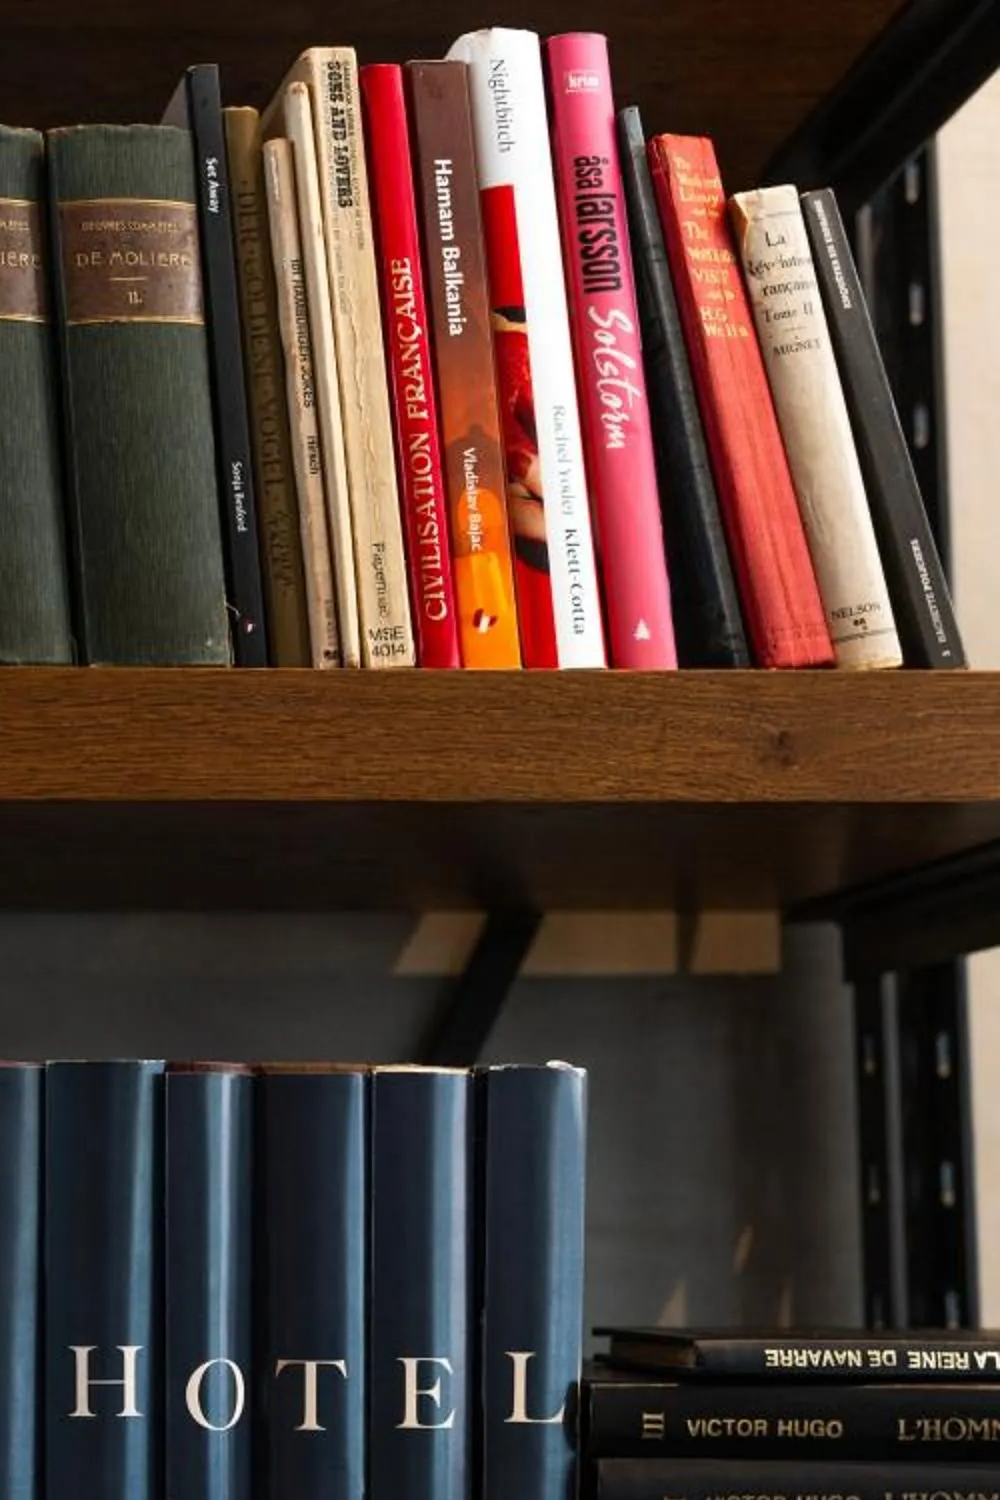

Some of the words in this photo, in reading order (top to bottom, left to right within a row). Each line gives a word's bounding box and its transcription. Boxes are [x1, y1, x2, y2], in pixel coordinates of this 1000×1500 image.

[330, 107, 346, 140] AND
[488, 58, 515, 152] Nightbitch
[433, 159, 455, 244] Hamam
[572, 155, 609, 190] åsa
[76, 252, 101, 268] DE
[574, 192, 624, 295] larsson
[441, 247, 466, 336] Balkania
[390, 257, 429, 421] FRANÇAISE
[584, 305, 642, 450] Solstorm
[461, 448, 482, 512] Vladislav
[406, 431, 449, 621] CIVILISATION
[561, 526, 588, 636] Klett-Cotta
[68, 1343, 568, 1433] HOTEL
[764, 1348, 863, 1369] NAVARRE
[868, 1349, 898, 1369] DE
[906, 1349, 969, 1370] REINE
[974, 1349, 1000, 1370] LA
[686, 1418, 768, 1439] VICTOR
[776, 1418, 844, 1440] HUGO
